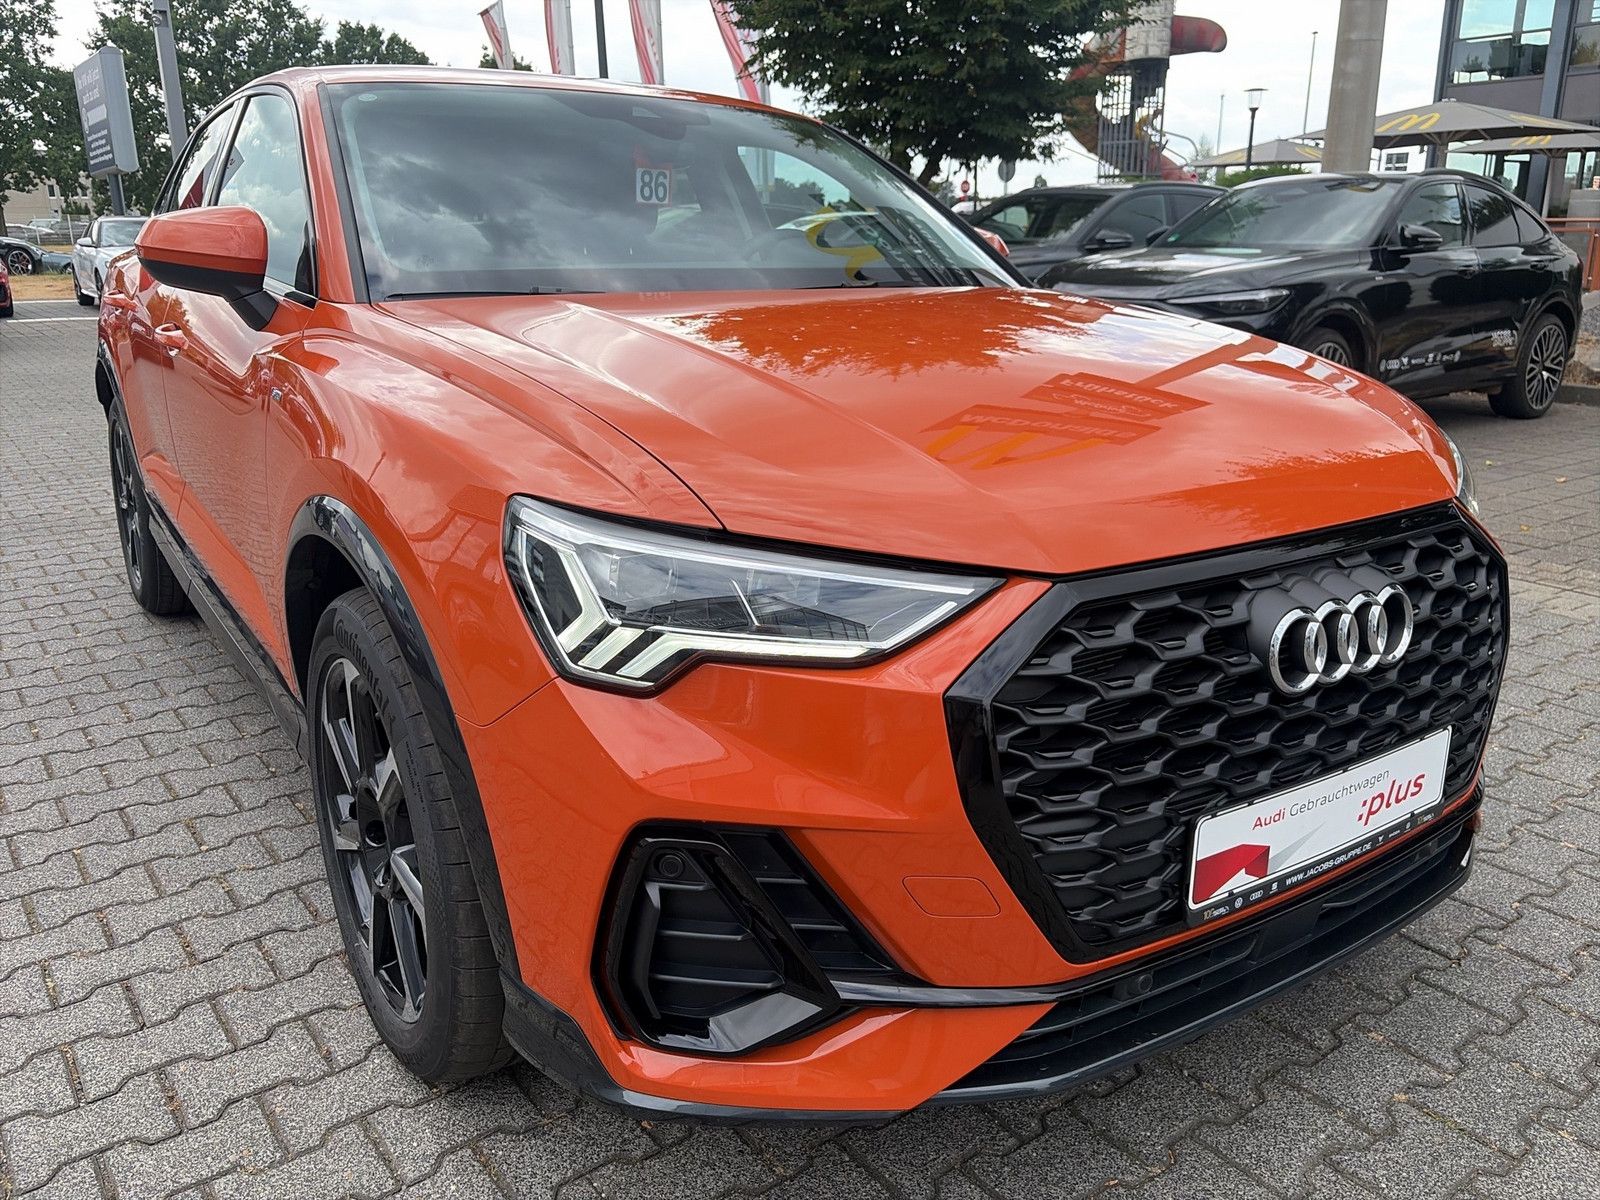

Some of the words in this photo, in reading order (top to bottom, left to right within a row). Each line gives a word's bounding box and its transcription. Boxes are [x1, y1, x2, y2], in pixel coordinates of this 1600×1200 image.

[639, 169, 668, 203] 86
[1252, 807, 1286, 831] Audi
[1289, 768, 1391, 818] Gebrauchtwagen
[1285, 841, 1373, 886] WWW.JACOBS-GRUPPE.DE
